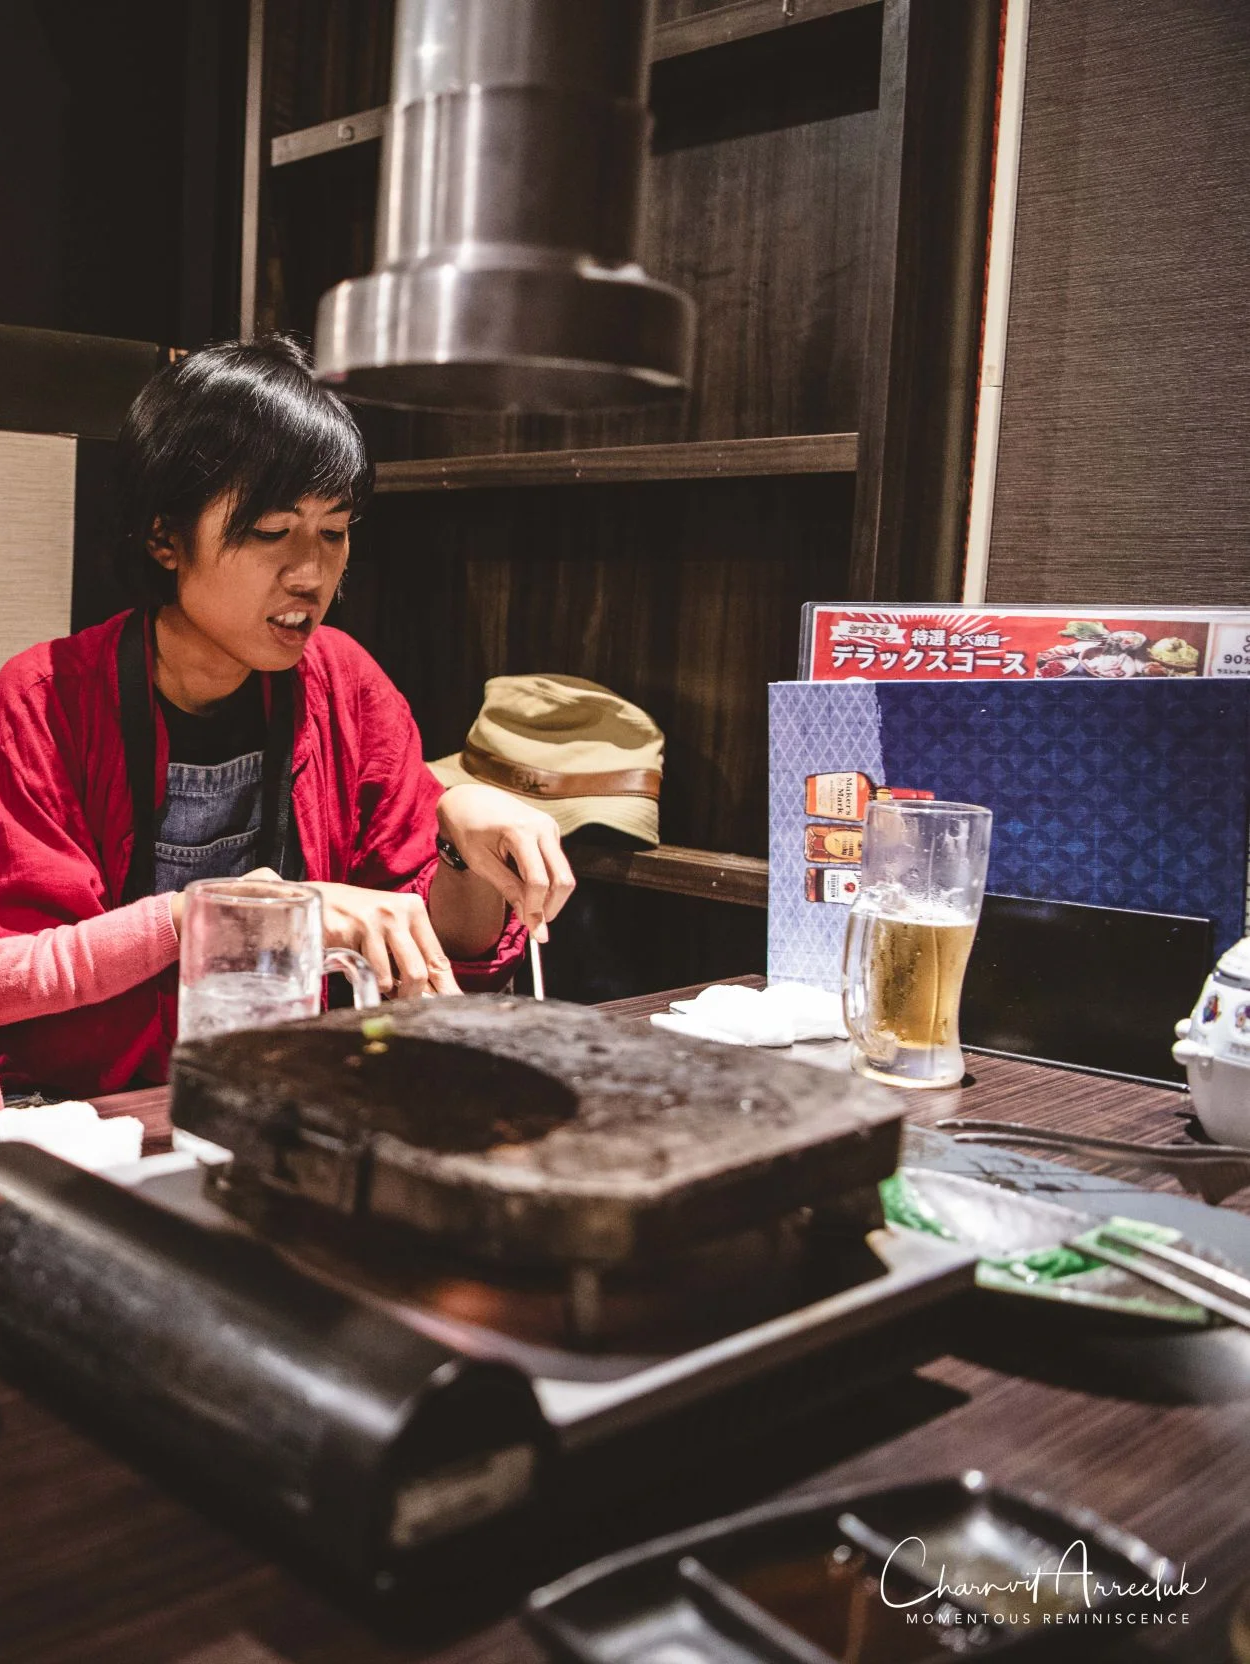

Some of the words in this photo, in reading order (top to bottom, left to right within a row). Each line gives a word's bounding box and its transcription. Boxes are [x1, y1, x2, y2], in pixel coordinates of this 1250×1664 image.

[848, 623, 890, 636] おすすめ
[911, 629, 946, 647] 特選
[949, 633, 1001, 648] 食べ放題
[831, 644, 1027, 676] デラックスコース
[837, 788, 845, 816] Mark
